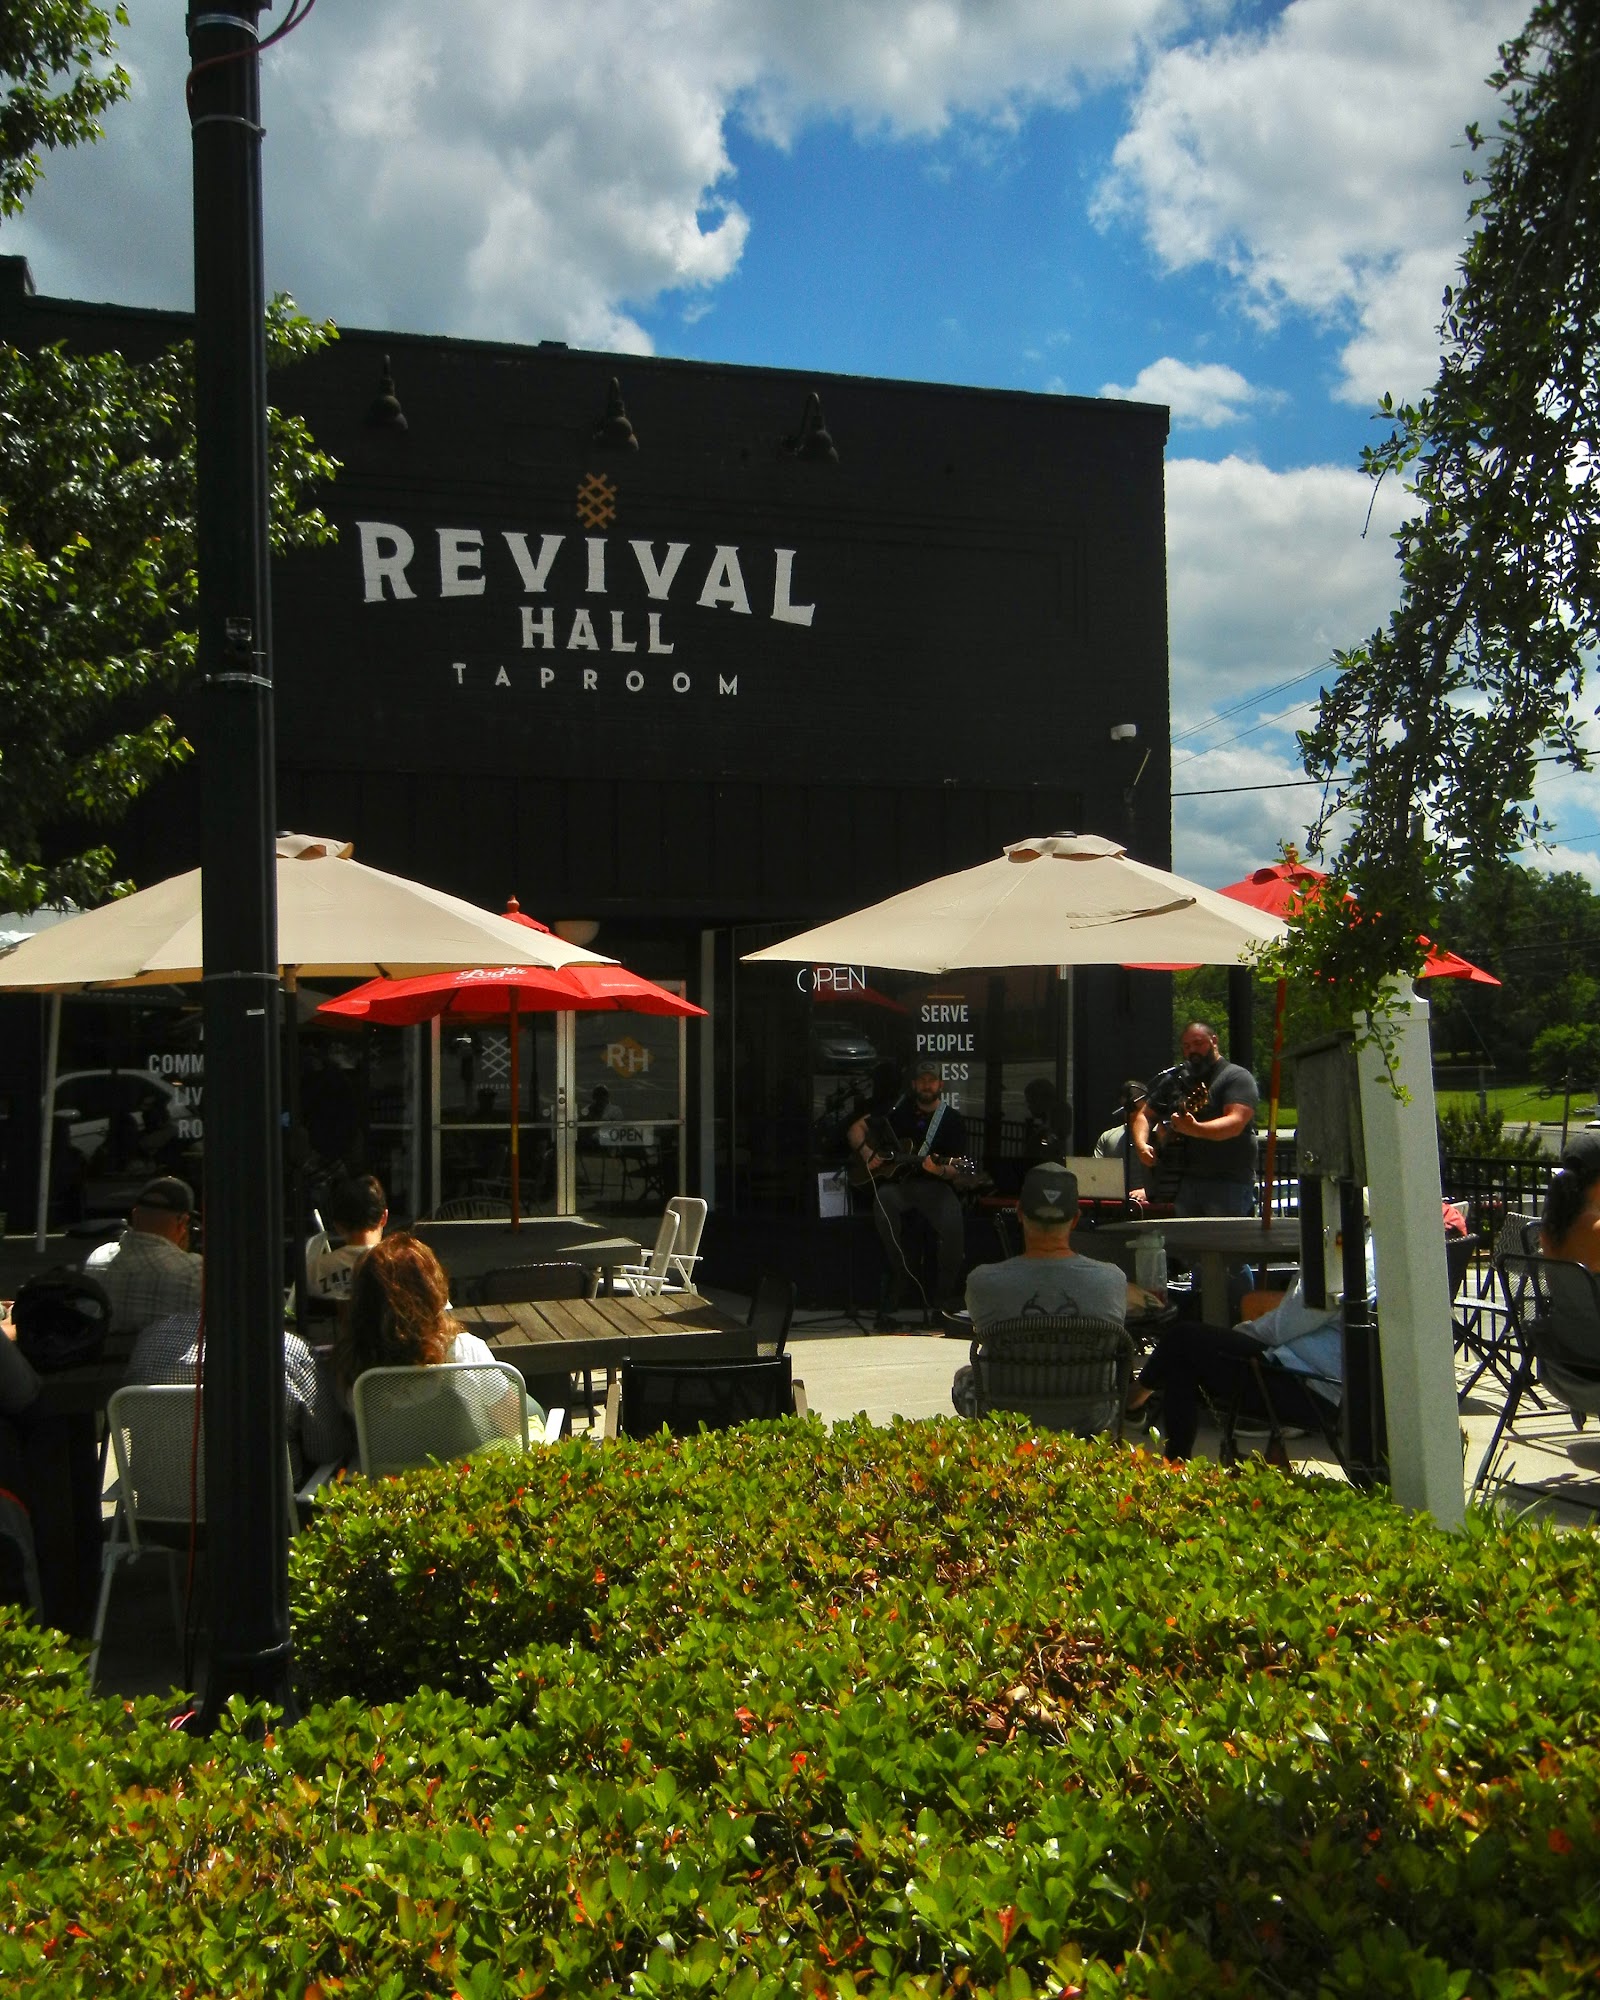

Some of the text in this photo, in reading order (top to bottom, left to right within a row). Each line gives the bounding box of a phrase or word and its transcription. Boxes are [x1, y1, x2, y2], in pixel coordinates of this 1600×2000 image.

[355, 521, 816, 626] REVIVAL
[519, 606, 675, 654] HALL
[452, 662, 738, 696] TAPROOM
[796, 966, 866, 993] OPEN
[921, 1004, 969, 1022] SERVE
[916, 1034, 975, 1052] PEOPLE
[148, 1054, 204, 1074] COMM
[606, 1043, 649, 1072] RH
[941, 1063, 969, 1081] ESS
[174, 1087, 204, 1106] LIV
[178, 1119, 203, 1138] RO
[609, 1128, 643, 1143] OPEN
